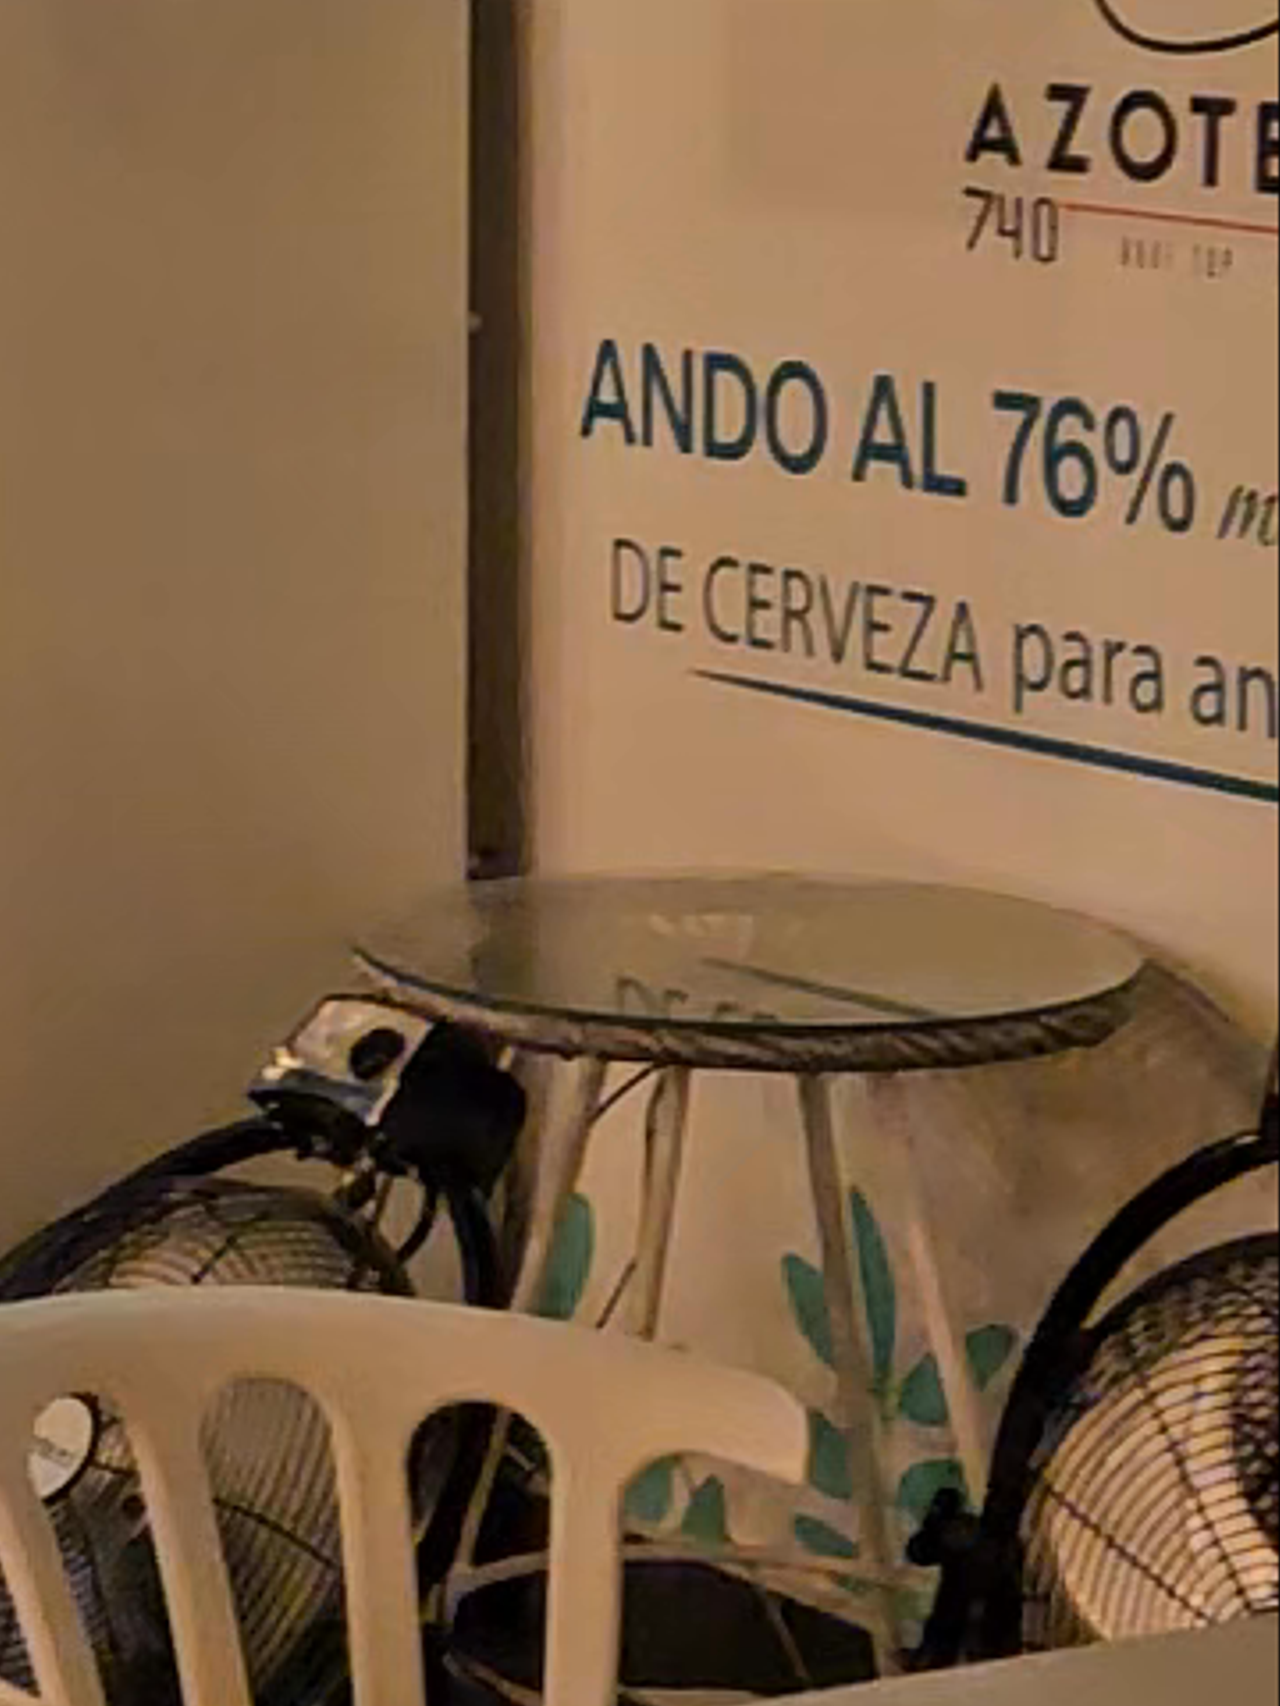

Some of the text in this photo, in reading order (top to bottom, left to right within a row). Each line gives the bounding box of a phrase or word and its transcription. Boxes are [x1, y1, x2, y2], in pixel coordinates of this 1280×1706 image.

[961, 186, 1058, 264] 740
[580, 339, 828, 475] ANDO
[851, 374, 967, 497] AL
[992, 389, 1196, 533] 76%
[611, 538, 1279, 739] DE CERVEZA para an
